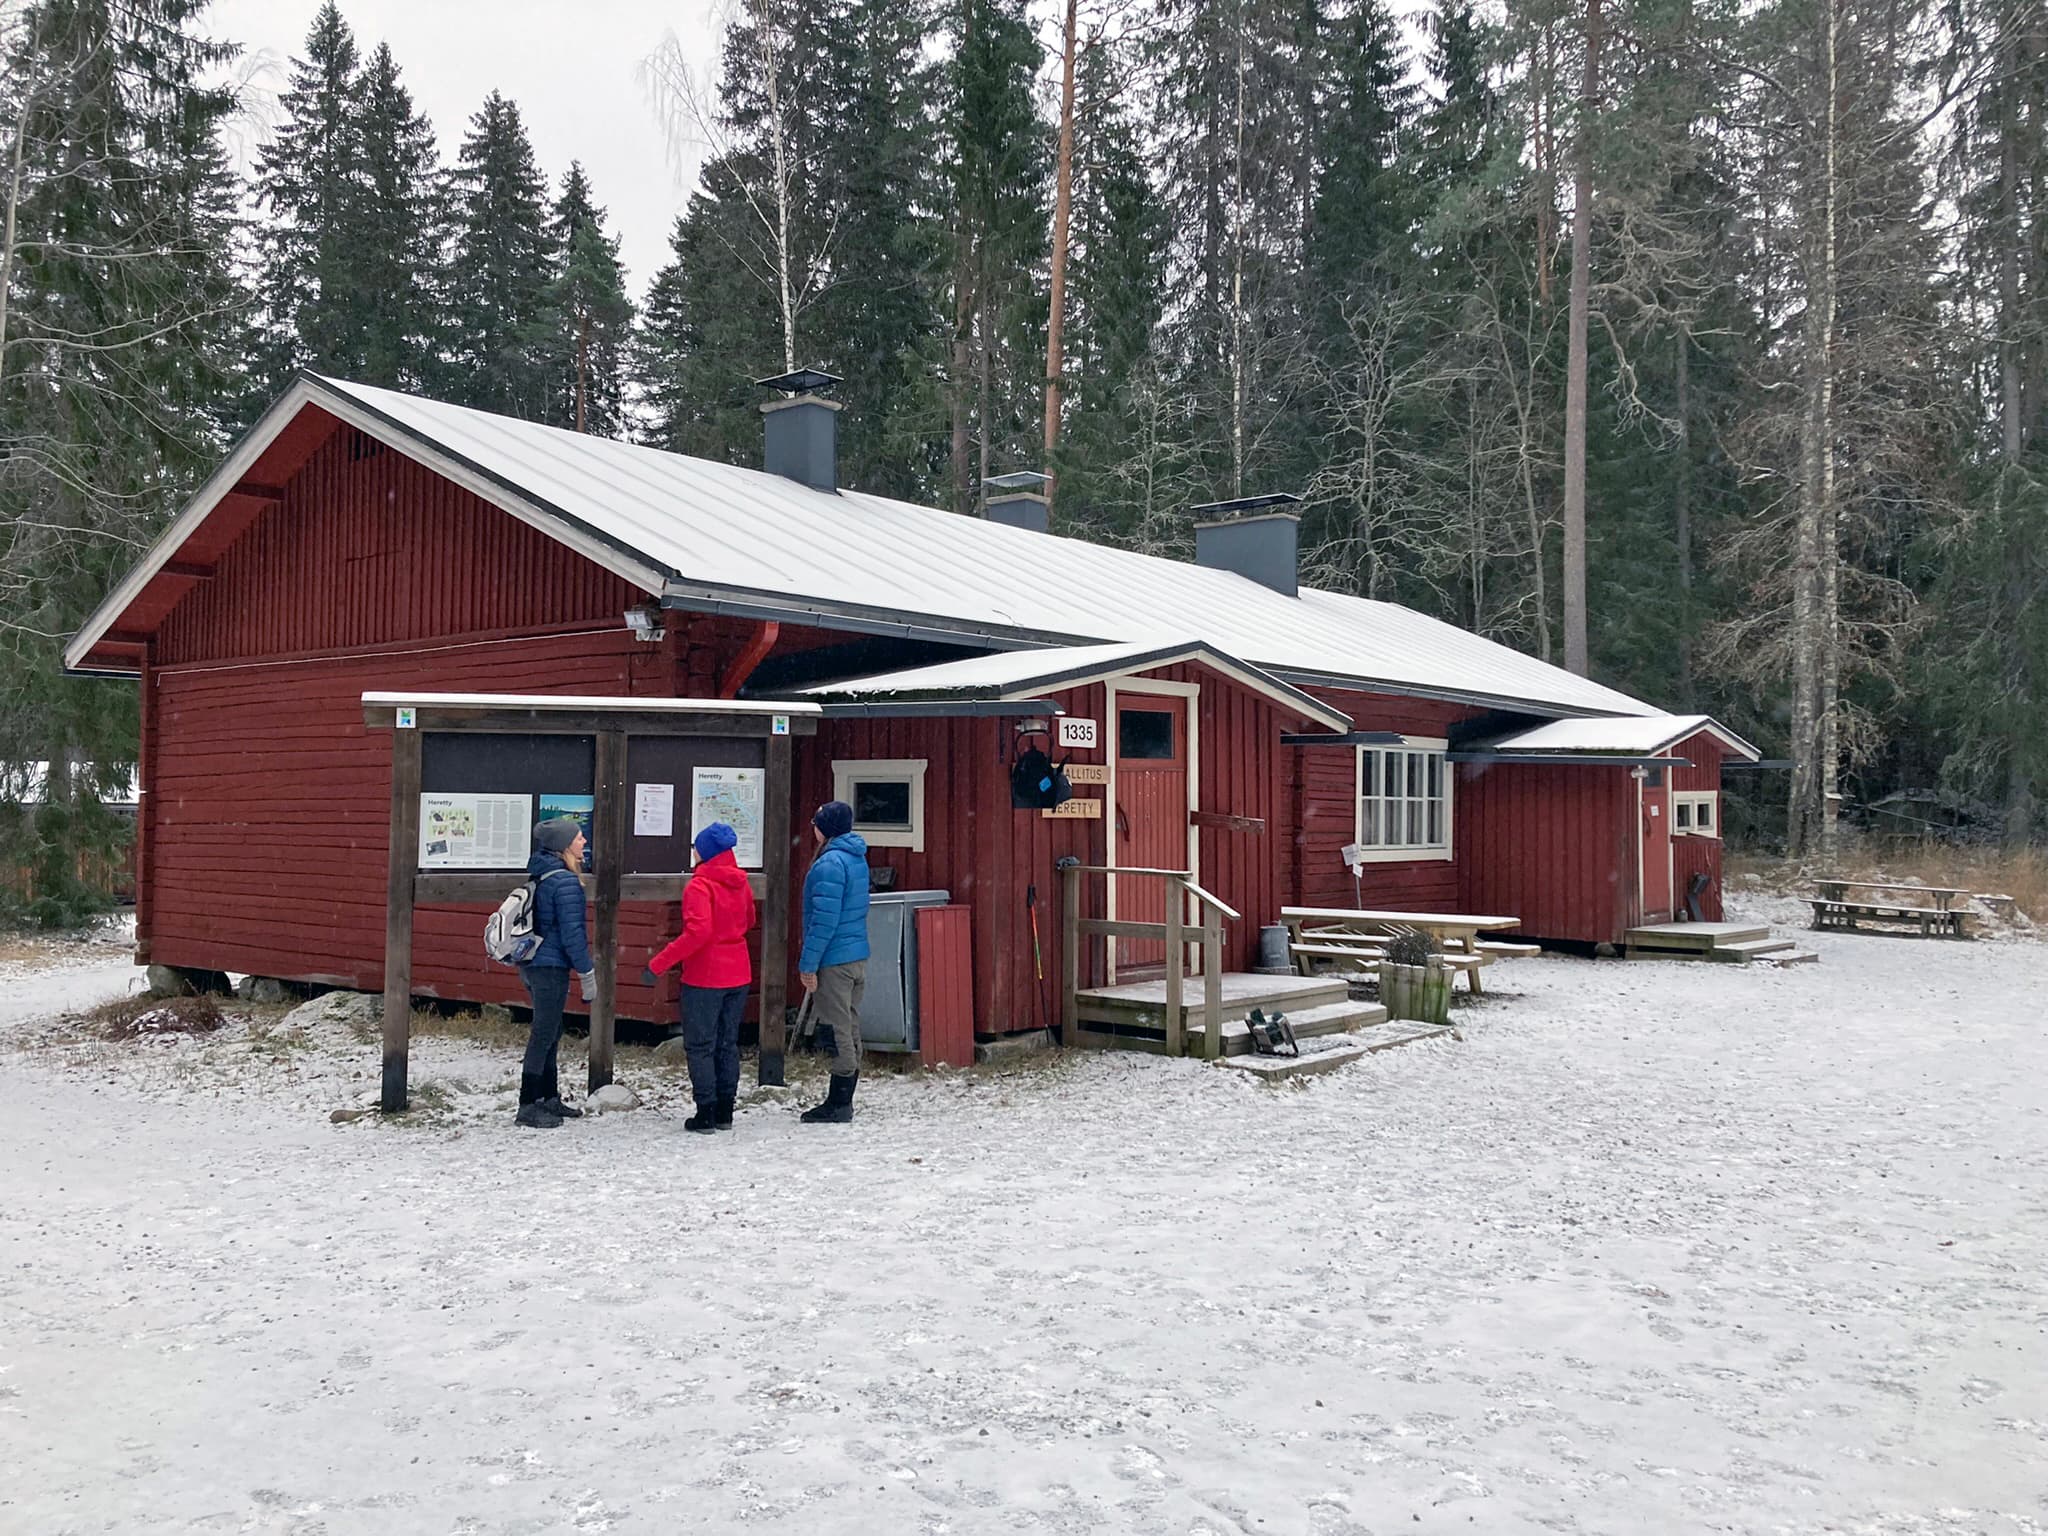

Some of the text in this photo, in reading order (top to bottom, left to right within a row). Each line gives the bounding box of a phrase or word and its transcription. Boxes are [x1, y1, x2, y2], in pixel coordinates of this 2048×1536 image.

[1064, 724, 1093, 741] 1335
[1065, 768, 1102, 780] ALLITUS
[1057, 802, 1094, 814] ERETTY
